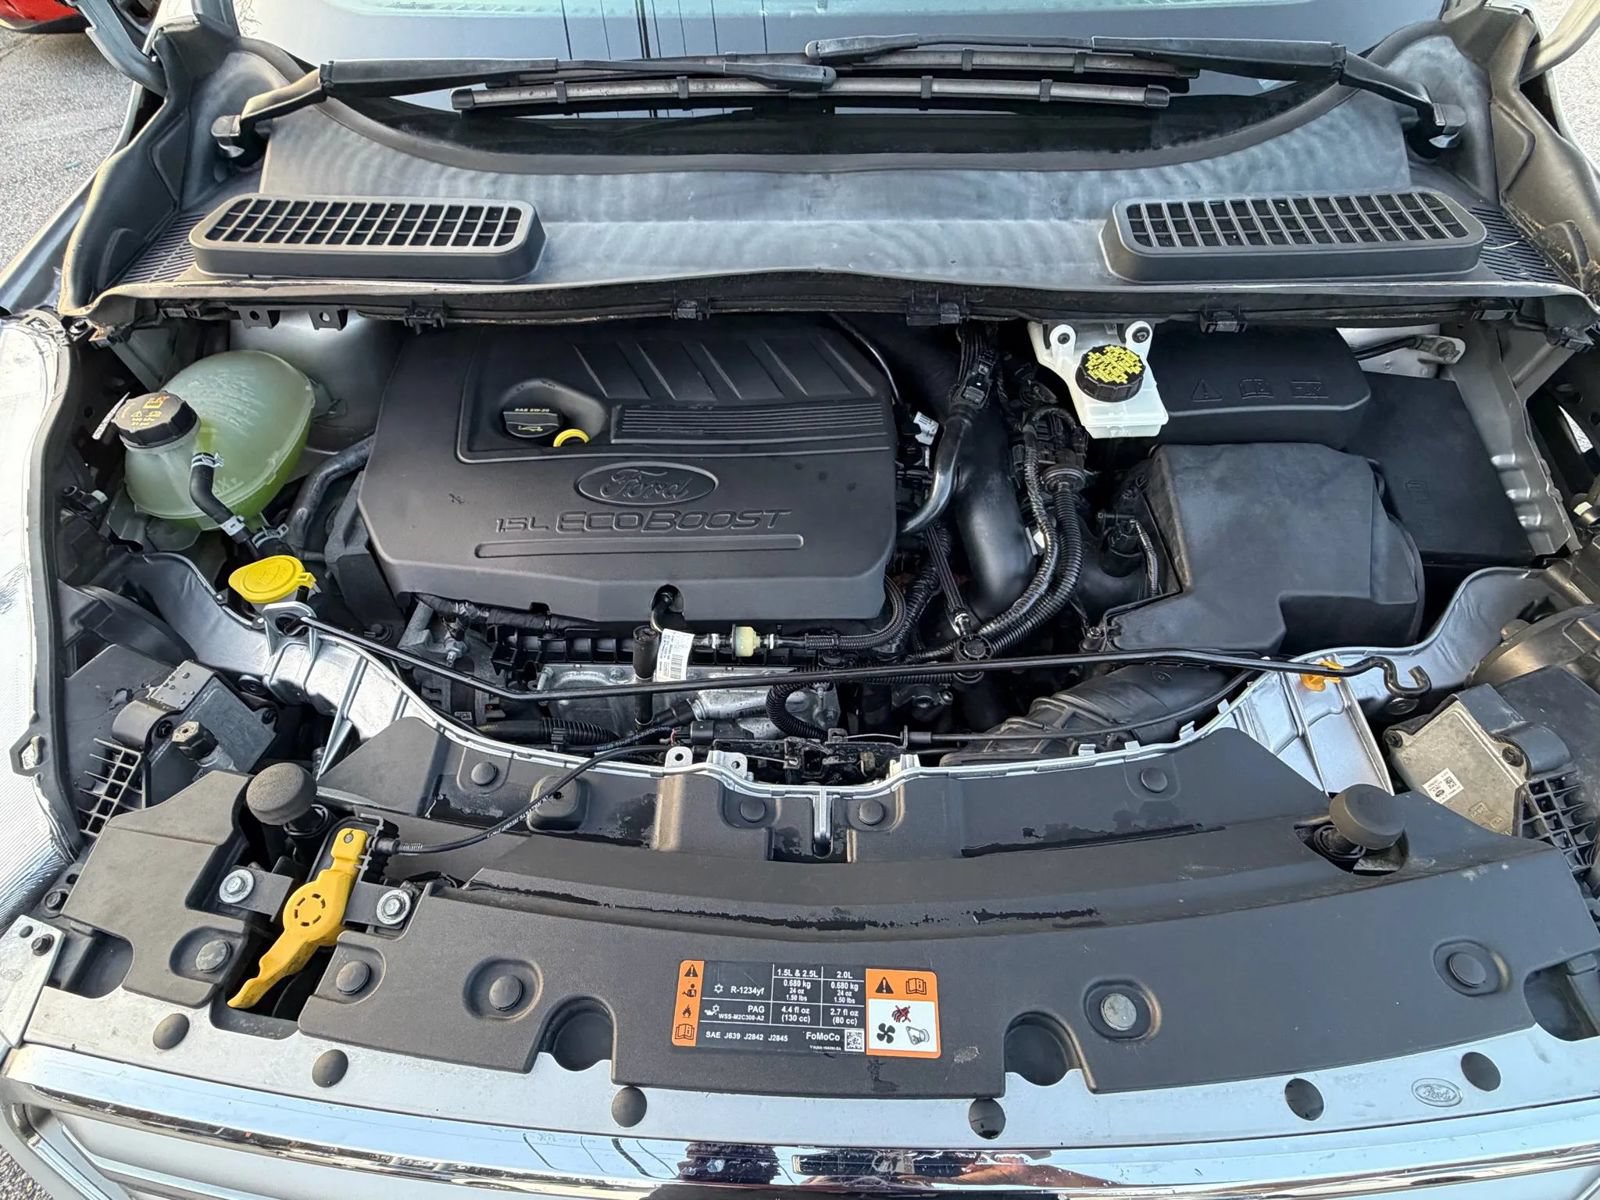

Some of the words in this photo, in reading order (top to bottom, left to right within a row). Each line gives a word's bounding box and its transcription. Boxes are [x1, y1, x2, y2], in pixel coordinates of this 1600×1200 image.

[599, 468, 694, 500] Ford
[496, 516, 549, 534] 1.5L
[777, 968, 793, 977] 1.5L
[794, 969, 801, 977] &
[802, 970, 819, 978] 2.5L
[836, 971, 854, 979] 2.0L
[783, 979, 801, 987] 0.680
[802, 980, 812, 989] kg
[830, 981, 849, 990] 0.680
[850, 982, 859, 992] kg
[730, 985, 765, 996] R-1234yf
[837, 989, 845, 997] 24
[747, 1004, 765, 1014] PAG
[781, 1006, 793, 1014] 4.4
[793, 1006, 800, 1015] fl
[800, 1007, 811, 1015] oz
[830, 1008, 842, 1017] 2.7
[842, 1008, 849, 1017] fl
[849, 1010, 859, 1018] oz
[781, 1014, 798, 1023] (130
[798, 1014, 811, 1024] cc)
[832, 1017, 845, 1026] (80
[845, 1017, 858, 1027] cc)
[705, 1031, 721, 1039] SAE
[724, 1032, 741, 1040] J639
[805, 1031, 841, 1042] FoMoCo
